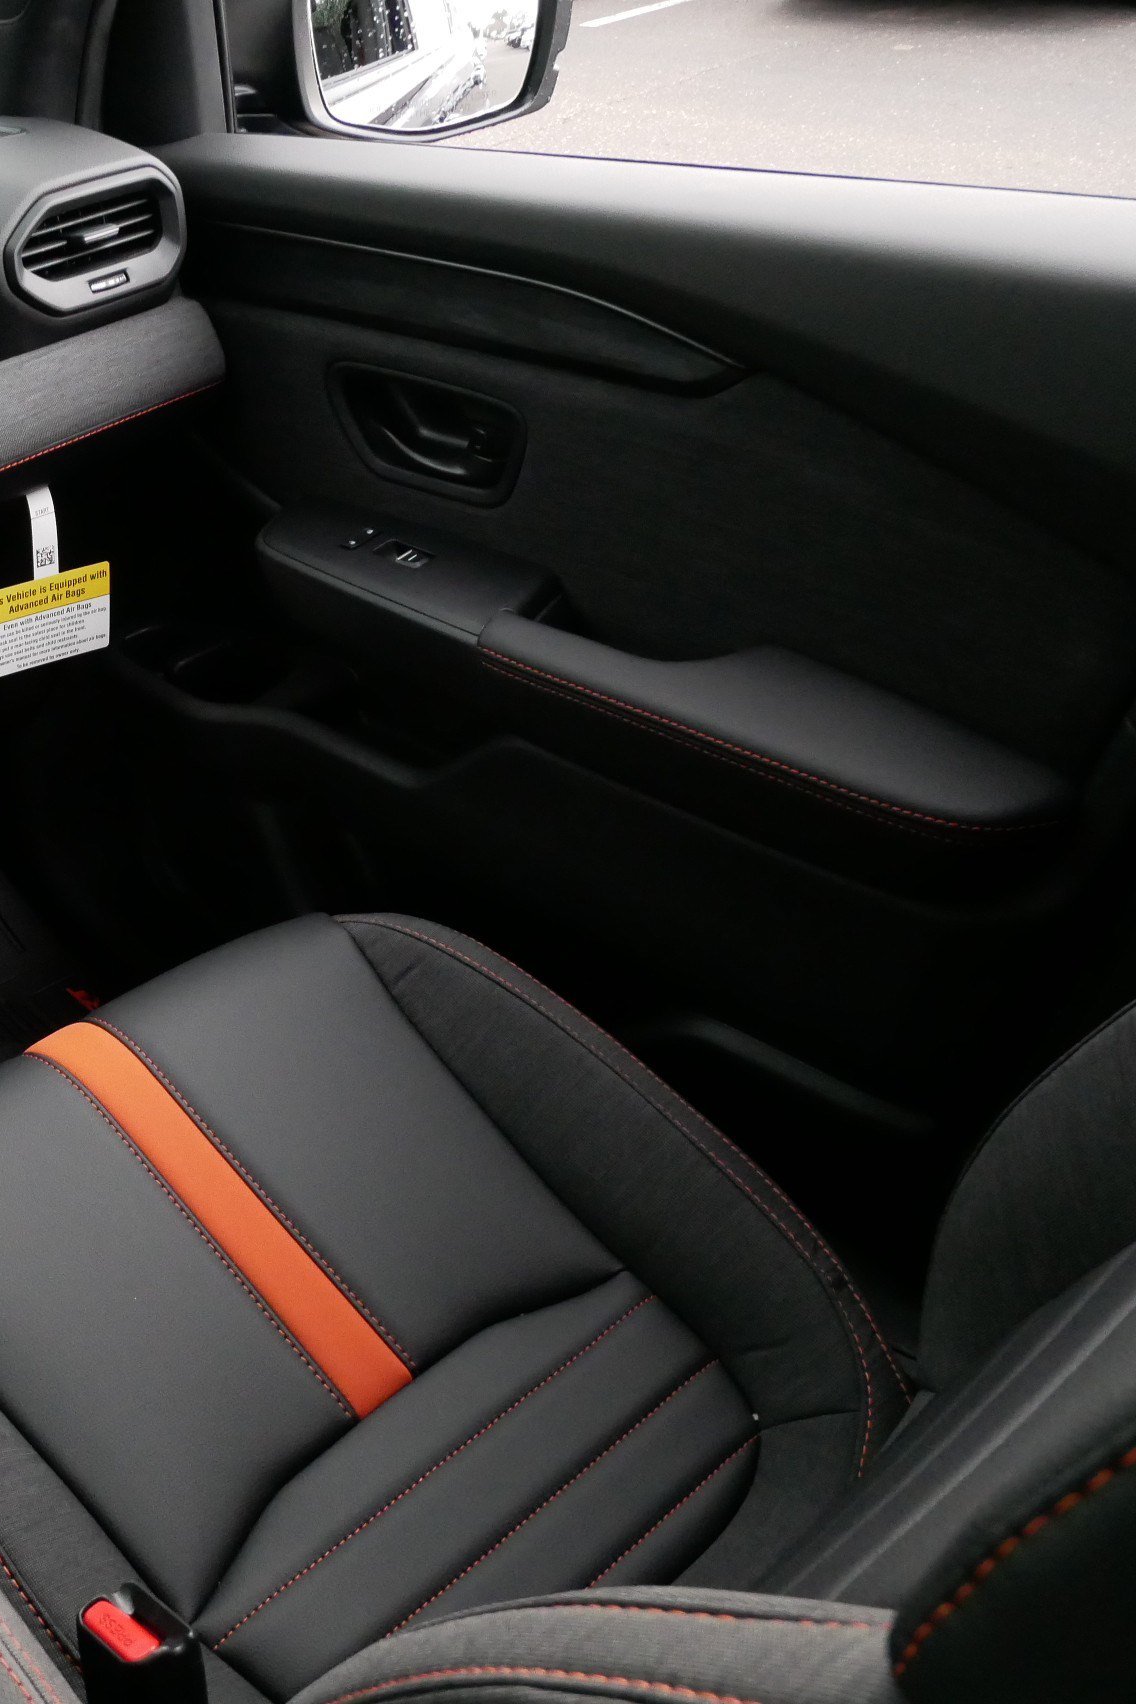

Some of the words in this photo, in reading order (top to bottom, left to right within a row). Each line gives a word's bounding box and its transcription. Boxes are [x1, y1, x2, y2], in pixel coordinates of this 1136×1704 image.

[6, 588, 37, 603] Vehicle
[39, 586, 47, 594] is
[49, 574, 87, 592] Equipped
[89, 569, 107, 581] with
[9, 595, 49, 614] Advanced
[51, 593, 63, 603] Air
[65, 588, 86, 599] Bags
[3, 623, 18, 631] Even
[20, 618, 33, 626] with
[34, 608, 65, 622] Advanced
[66, 606, 75, 614] Air
[76, 602, 92, 611] Bags
